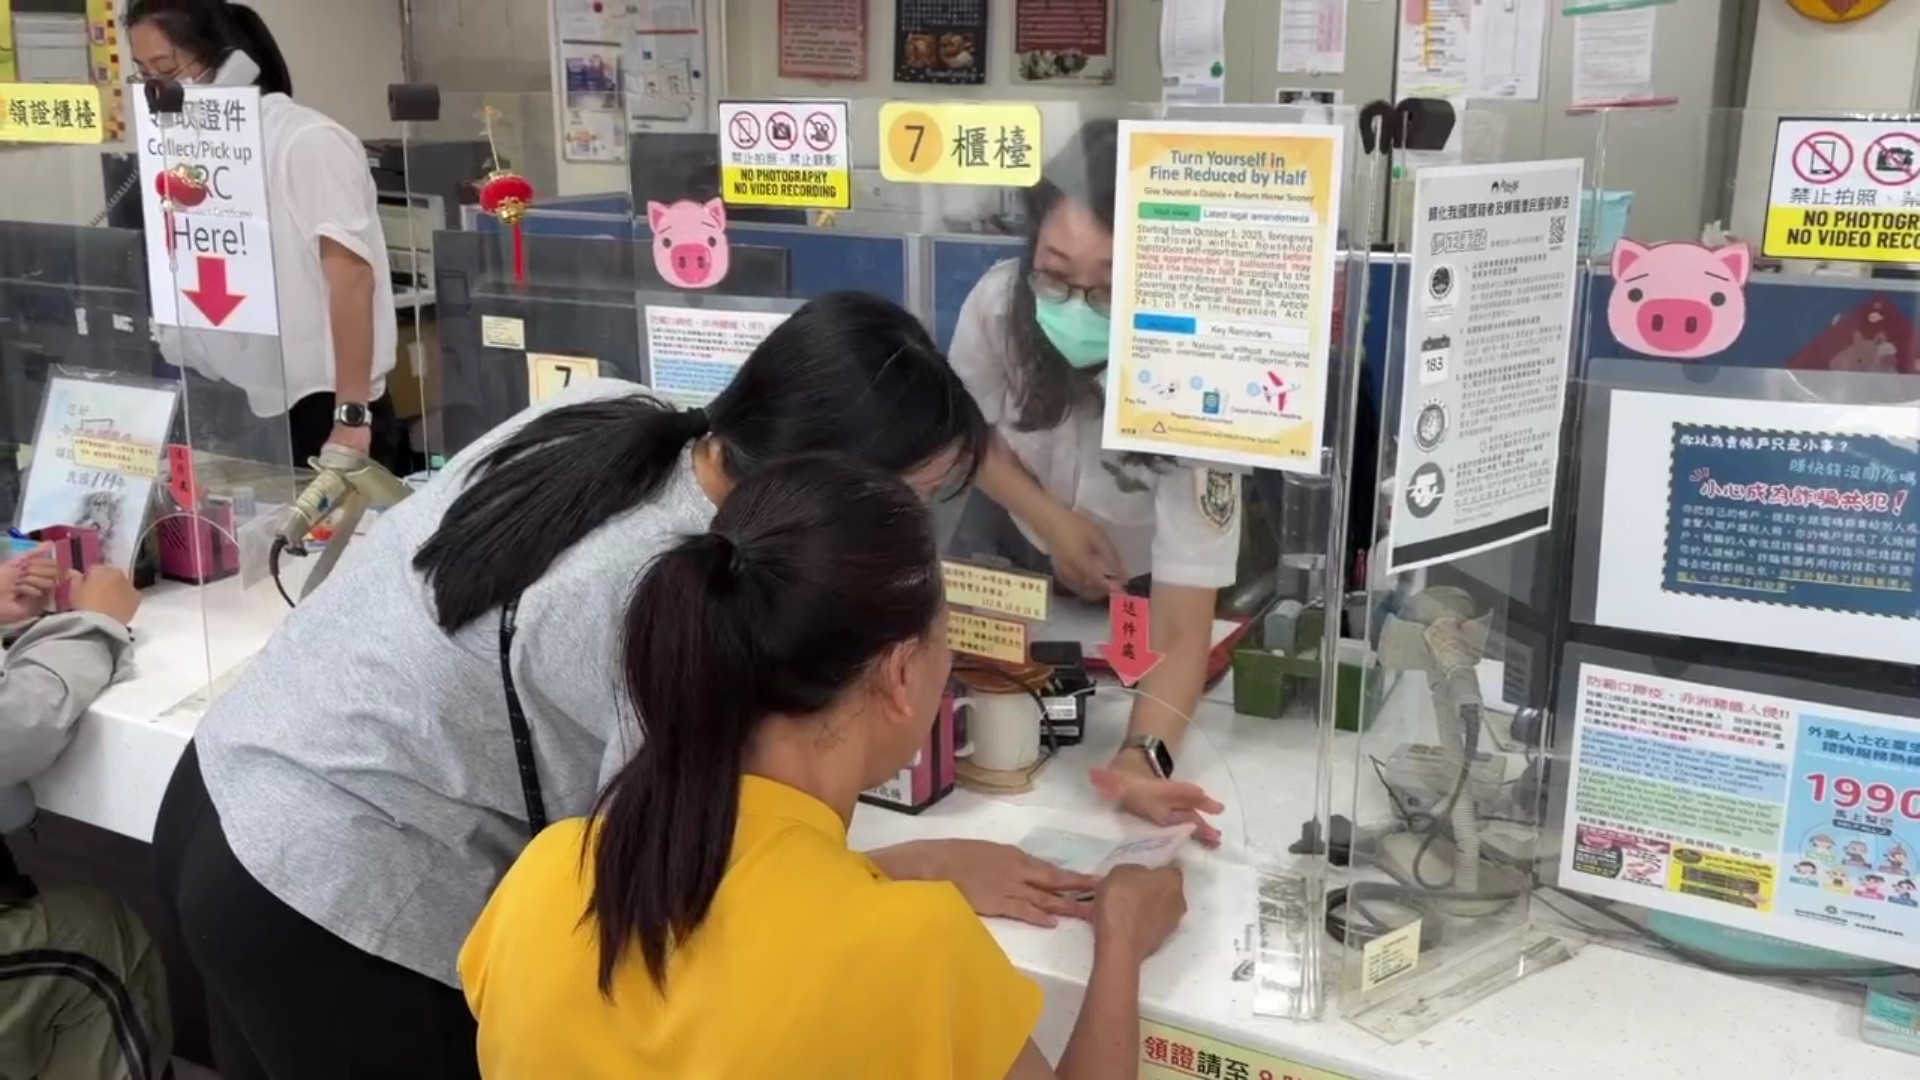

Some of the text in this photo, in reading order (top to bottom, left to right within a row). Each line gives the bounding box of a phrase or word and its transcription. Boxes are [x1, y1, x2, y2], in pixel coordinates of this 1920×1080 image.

[9, 98, 96, 129] 領證櫃檯
[150, 98, 246, 132] 取證件
[148, 138, 252, 165] Collect/Pick up
[904, 124, 1033, 169] 7 櫃檯
[1170, 150, 1285, 168] Turn Yourself in
[740, 168, 828, 183] NO PHOTOGRAPHY
[1150, 166, 1307, 187] Fine Reduced by Half
[734, 183, 836, 198] NO VIDEO RECORDING
[1803, 210, 1828, 227] NO
[173, 217, 247, 256] Here!
[1786, 228, 1812, 245] NO
[1818, 230, 1871, 247] VIDEO
[1210, 326, 1226, 337] Key
[1425, 356, 1444, 373] 183
[554, 365, 572, 388] 7
[1121, 600, 1138, 661] 送件處
[1805, 773, 1920, 820] 1990
